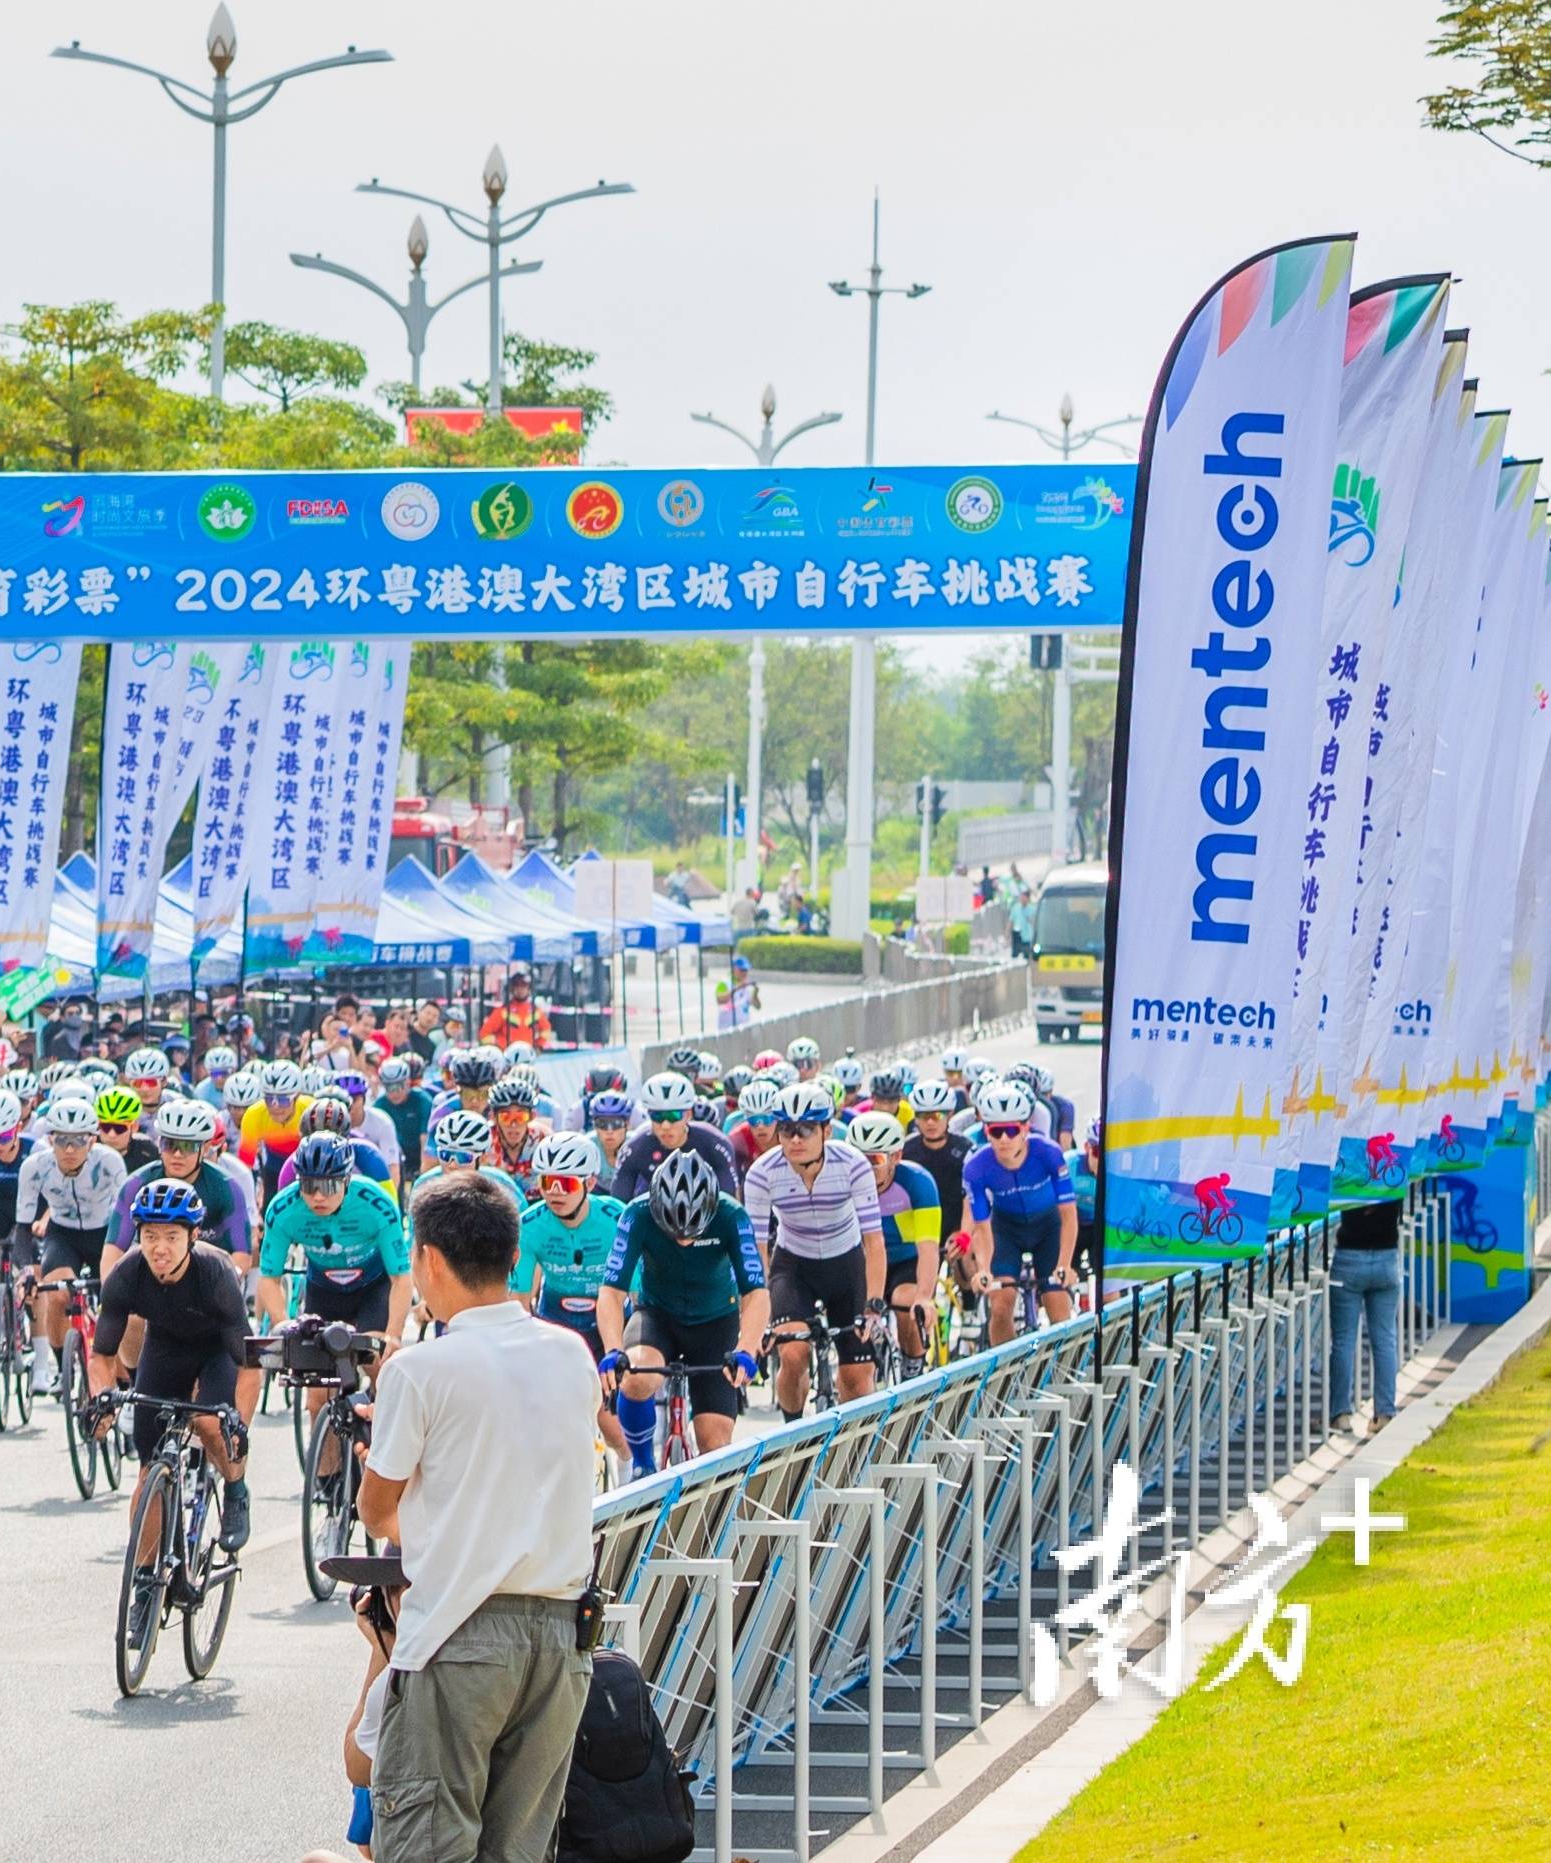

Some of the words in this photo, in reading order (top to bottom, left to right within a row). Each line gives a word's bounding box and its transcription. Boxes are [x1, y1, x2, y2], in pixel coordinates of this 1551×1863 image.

[175, 554, 1094, 614] 2024环粤港澳大湾区城市自行车挑战赛
[1191, 411, 1285, 944] mentech
[23, 702, 58, 889] 城市自行车挑战赛
[108, 682, 148, 896] 环粤港澳大湾区
[271, 694, 306, 890] 环粤港澳大湾区
[305, 714, 331, 877] 城市自行车挑战赛
[1132, 996, 1276, 1031] mentech
